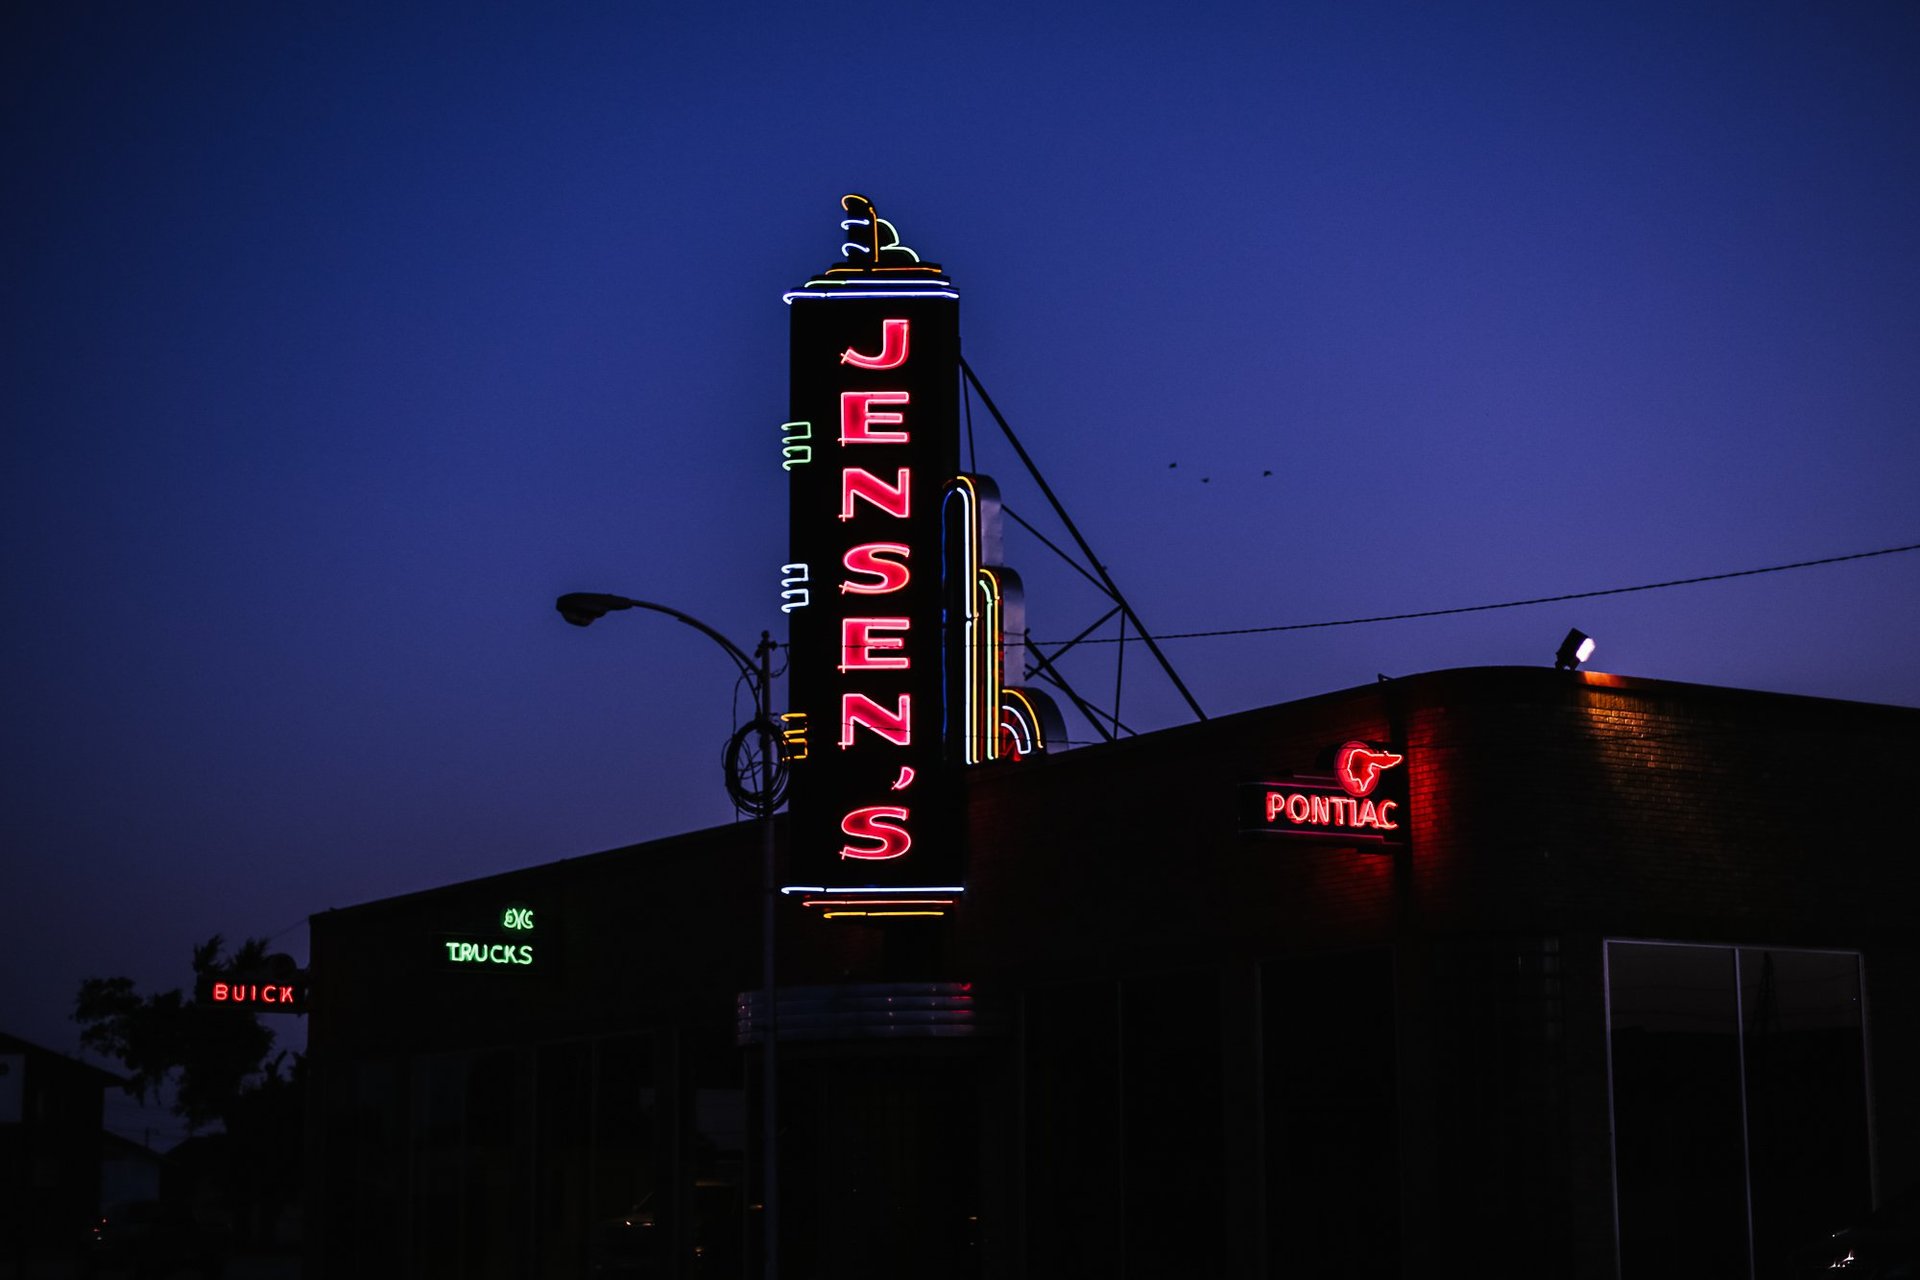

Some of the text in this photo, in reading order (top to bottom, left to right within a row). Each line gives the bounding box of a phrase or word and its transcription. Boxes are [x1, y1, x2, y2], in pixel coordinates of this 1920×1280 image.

[838, 318, 916, 862] JENSEN'S
[1265, 792, 1399, 831] PONTIAC
[445, 941, 533, 965] TRUCKS
[212, 982, 294, 1003] BUICK
